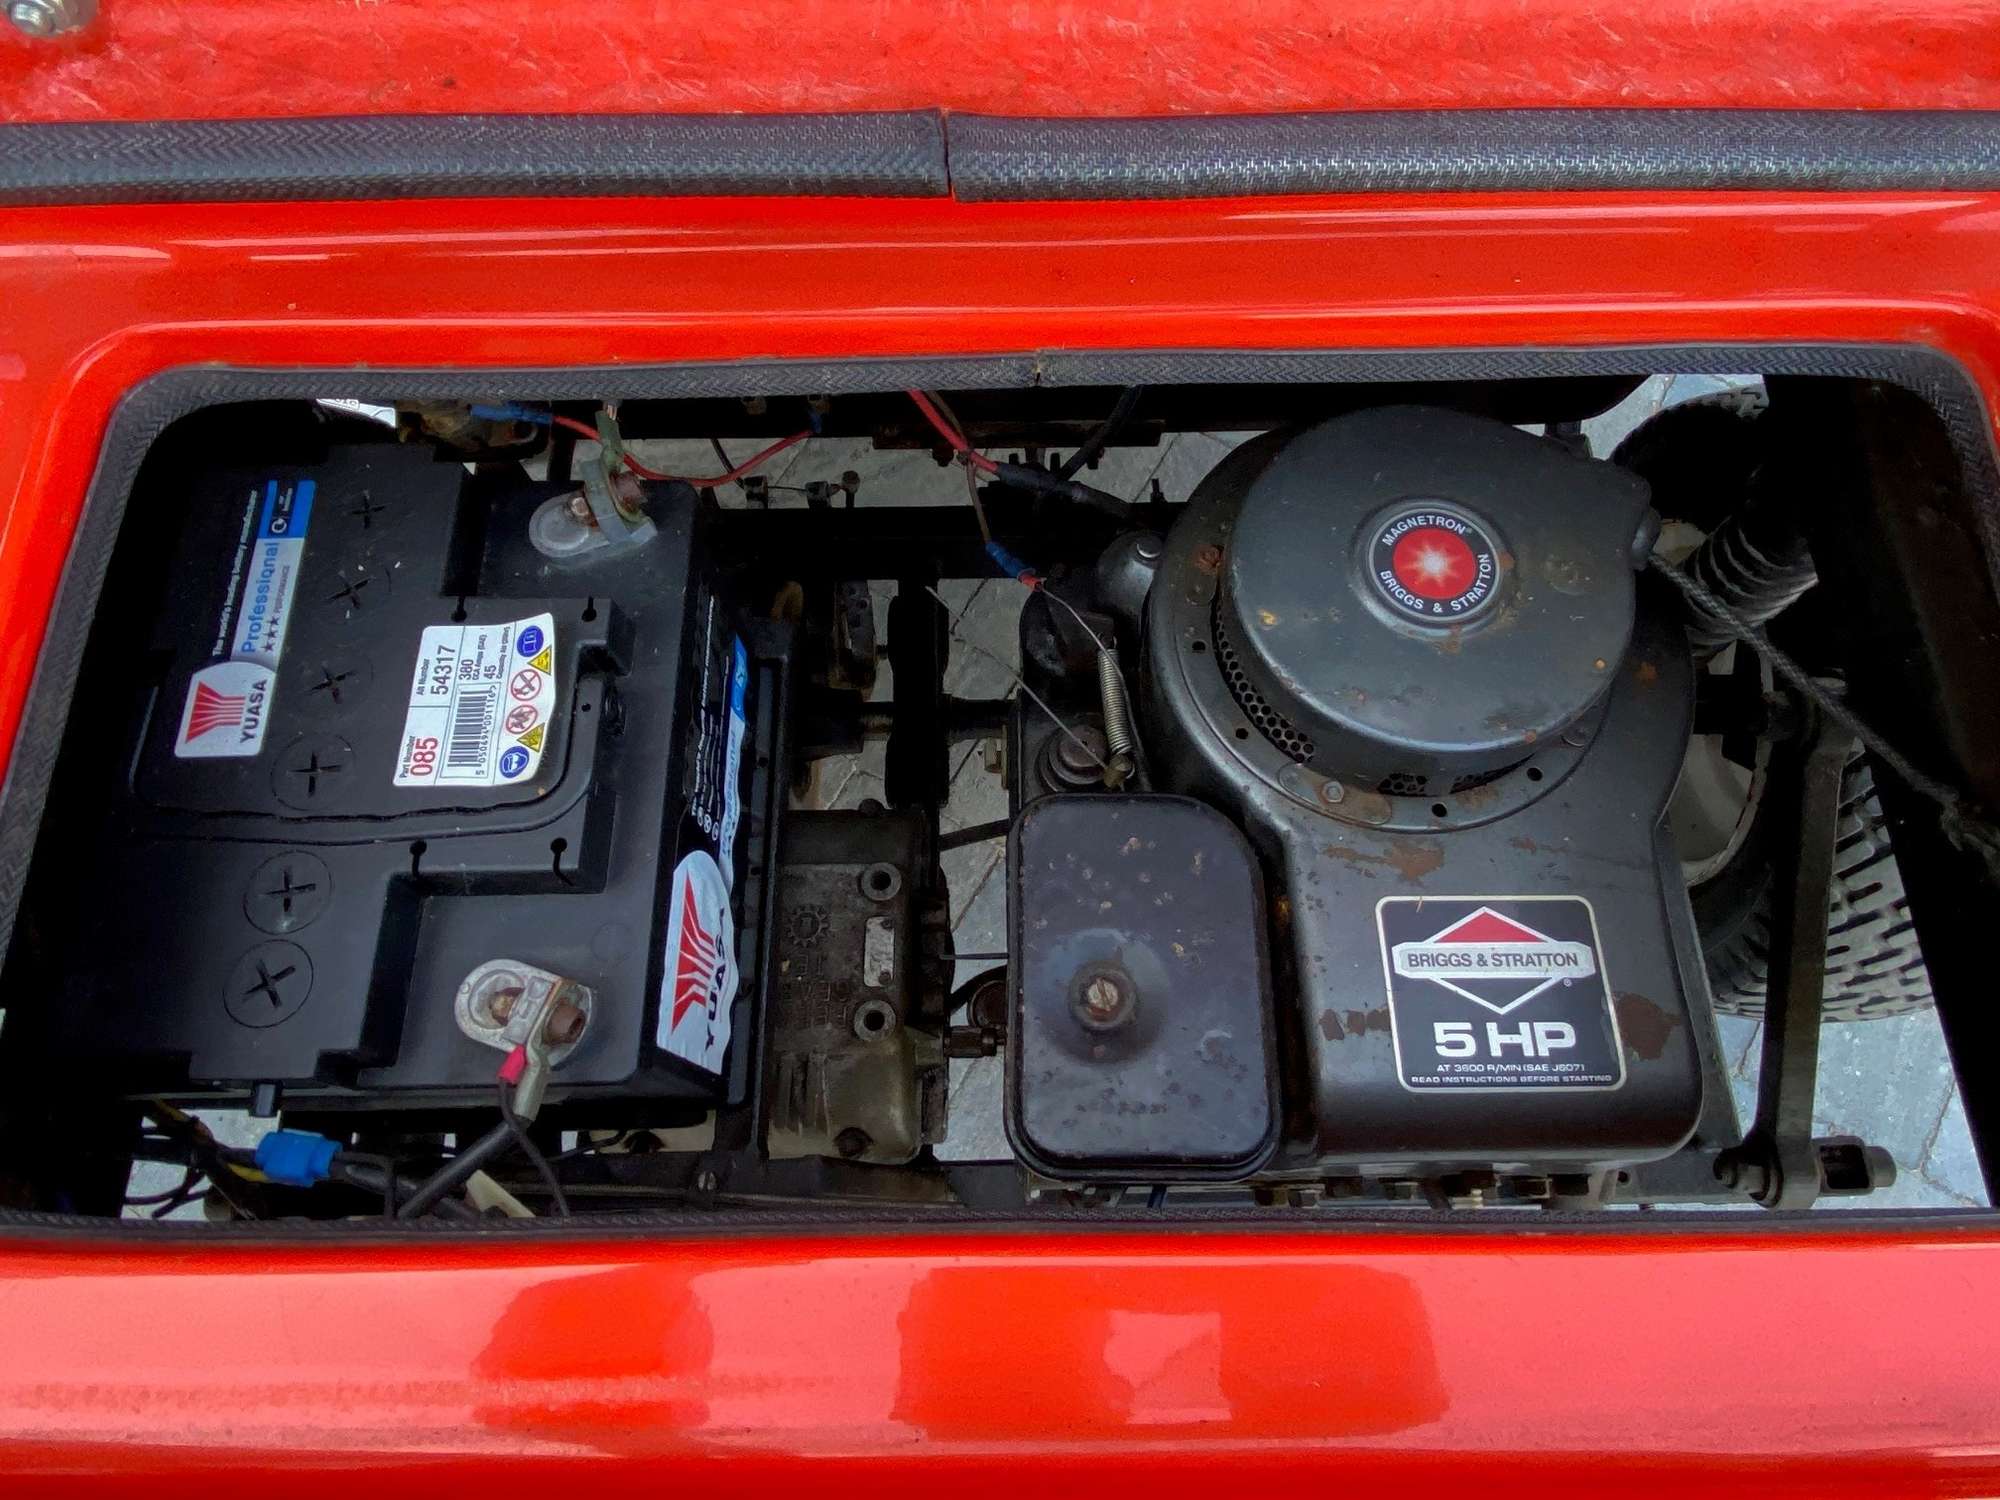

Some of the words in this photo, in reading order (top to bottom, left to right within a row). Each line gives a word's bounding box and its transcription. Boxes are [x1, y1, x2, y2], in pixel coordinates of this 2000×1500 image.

[1382, 515, 1466, 546] MAGNETRON
[1380, 570, 1424, 610] BRIGGS
[1433, 603, 1443, 613] &
[1450, 553, 1492, 611] STRATTON
[242, 541, 279, 654] Professional
[418, 658, 430, 685] Number
[431, 645, 456, 695] 54317
[459, 659, 474, 680] 380
[484, 665, 497, 679] 45
[240, 679, 267, 744] YUASA
[403, 735, 415, 763] Number
[410, 737, 438, 776] 085
[399, 763, 411, 778] Part
[1408, 953, 1473, 967] BRIGGS
[1477, 953, 1488, 966] &
[1492, 953, 1578, 967] STRATTON
[1433, 1022, 1476, 1058] 5
[1486, 1022, 1576, 1057] HP
[1437, 1064, 1450, 1072] AT
[1454, 1064, 1484, 1072] 3600
[1487, 1064, 1521, 1074] R/MIN
[1520, 1075, 1560, 1083] BEFORE
